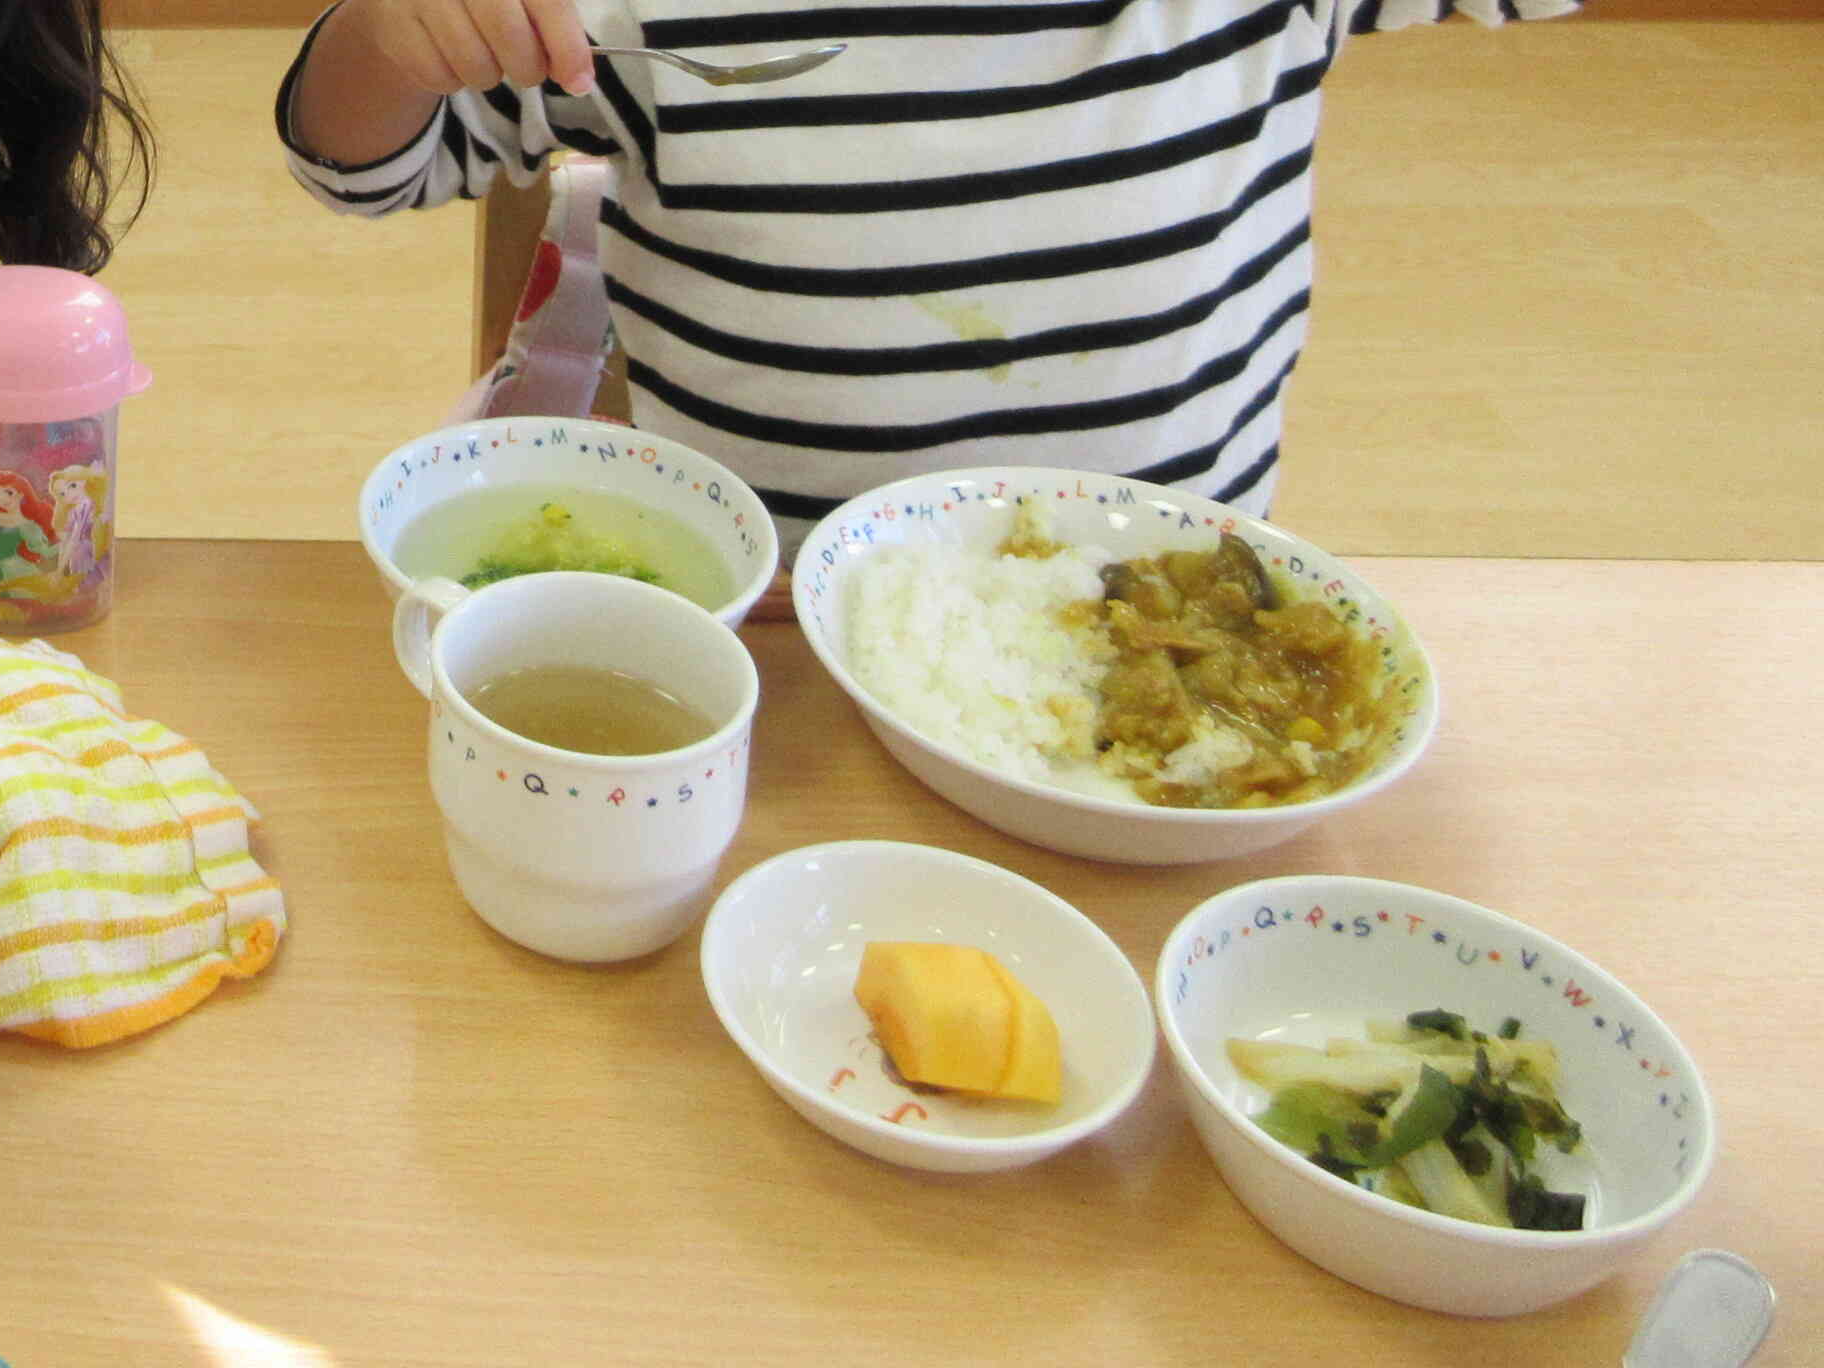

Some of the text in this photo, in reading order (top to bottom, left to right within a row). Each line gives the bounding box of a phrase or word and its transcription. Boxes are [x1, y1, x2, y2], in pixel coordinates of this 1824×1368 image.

[401, 460, 411, 477] I
[432, 446, 441, 464] J
[468, 441, 480, 459] K
[507, 427, 518, 443] L
[552, 428, 568, 444] M
[598, 443, 616, 462] N
[640, 448, 656, 464] O
[708, 482, 720, 504] Q
[839, 526, 850, 547] E
[919, 504, 933, 520] H
[951, 487, 967, 503] I
[991, 482, 1006, 498] J
[1075, 480, 1088, 498] L
[1116, 488, 1136, 504] M
[1180, 512, 1194, 528] A
[524, 774, 548, 795] Q
[607, 788, 625, 806] R
[678, 784, 693, 803] S
[1254, 906, 1277, 929] Q
[1304, 906, 1324, 928] R
[1352, 916, 1371, 937] S
[1405, 914, 1424, 936] T
[1456, 943, 1478, 965] U
[1522, 949, 1538, 970] V
[1564, 980, 1592, 1007] W
[1616, 1023, 1635, 1050] X
